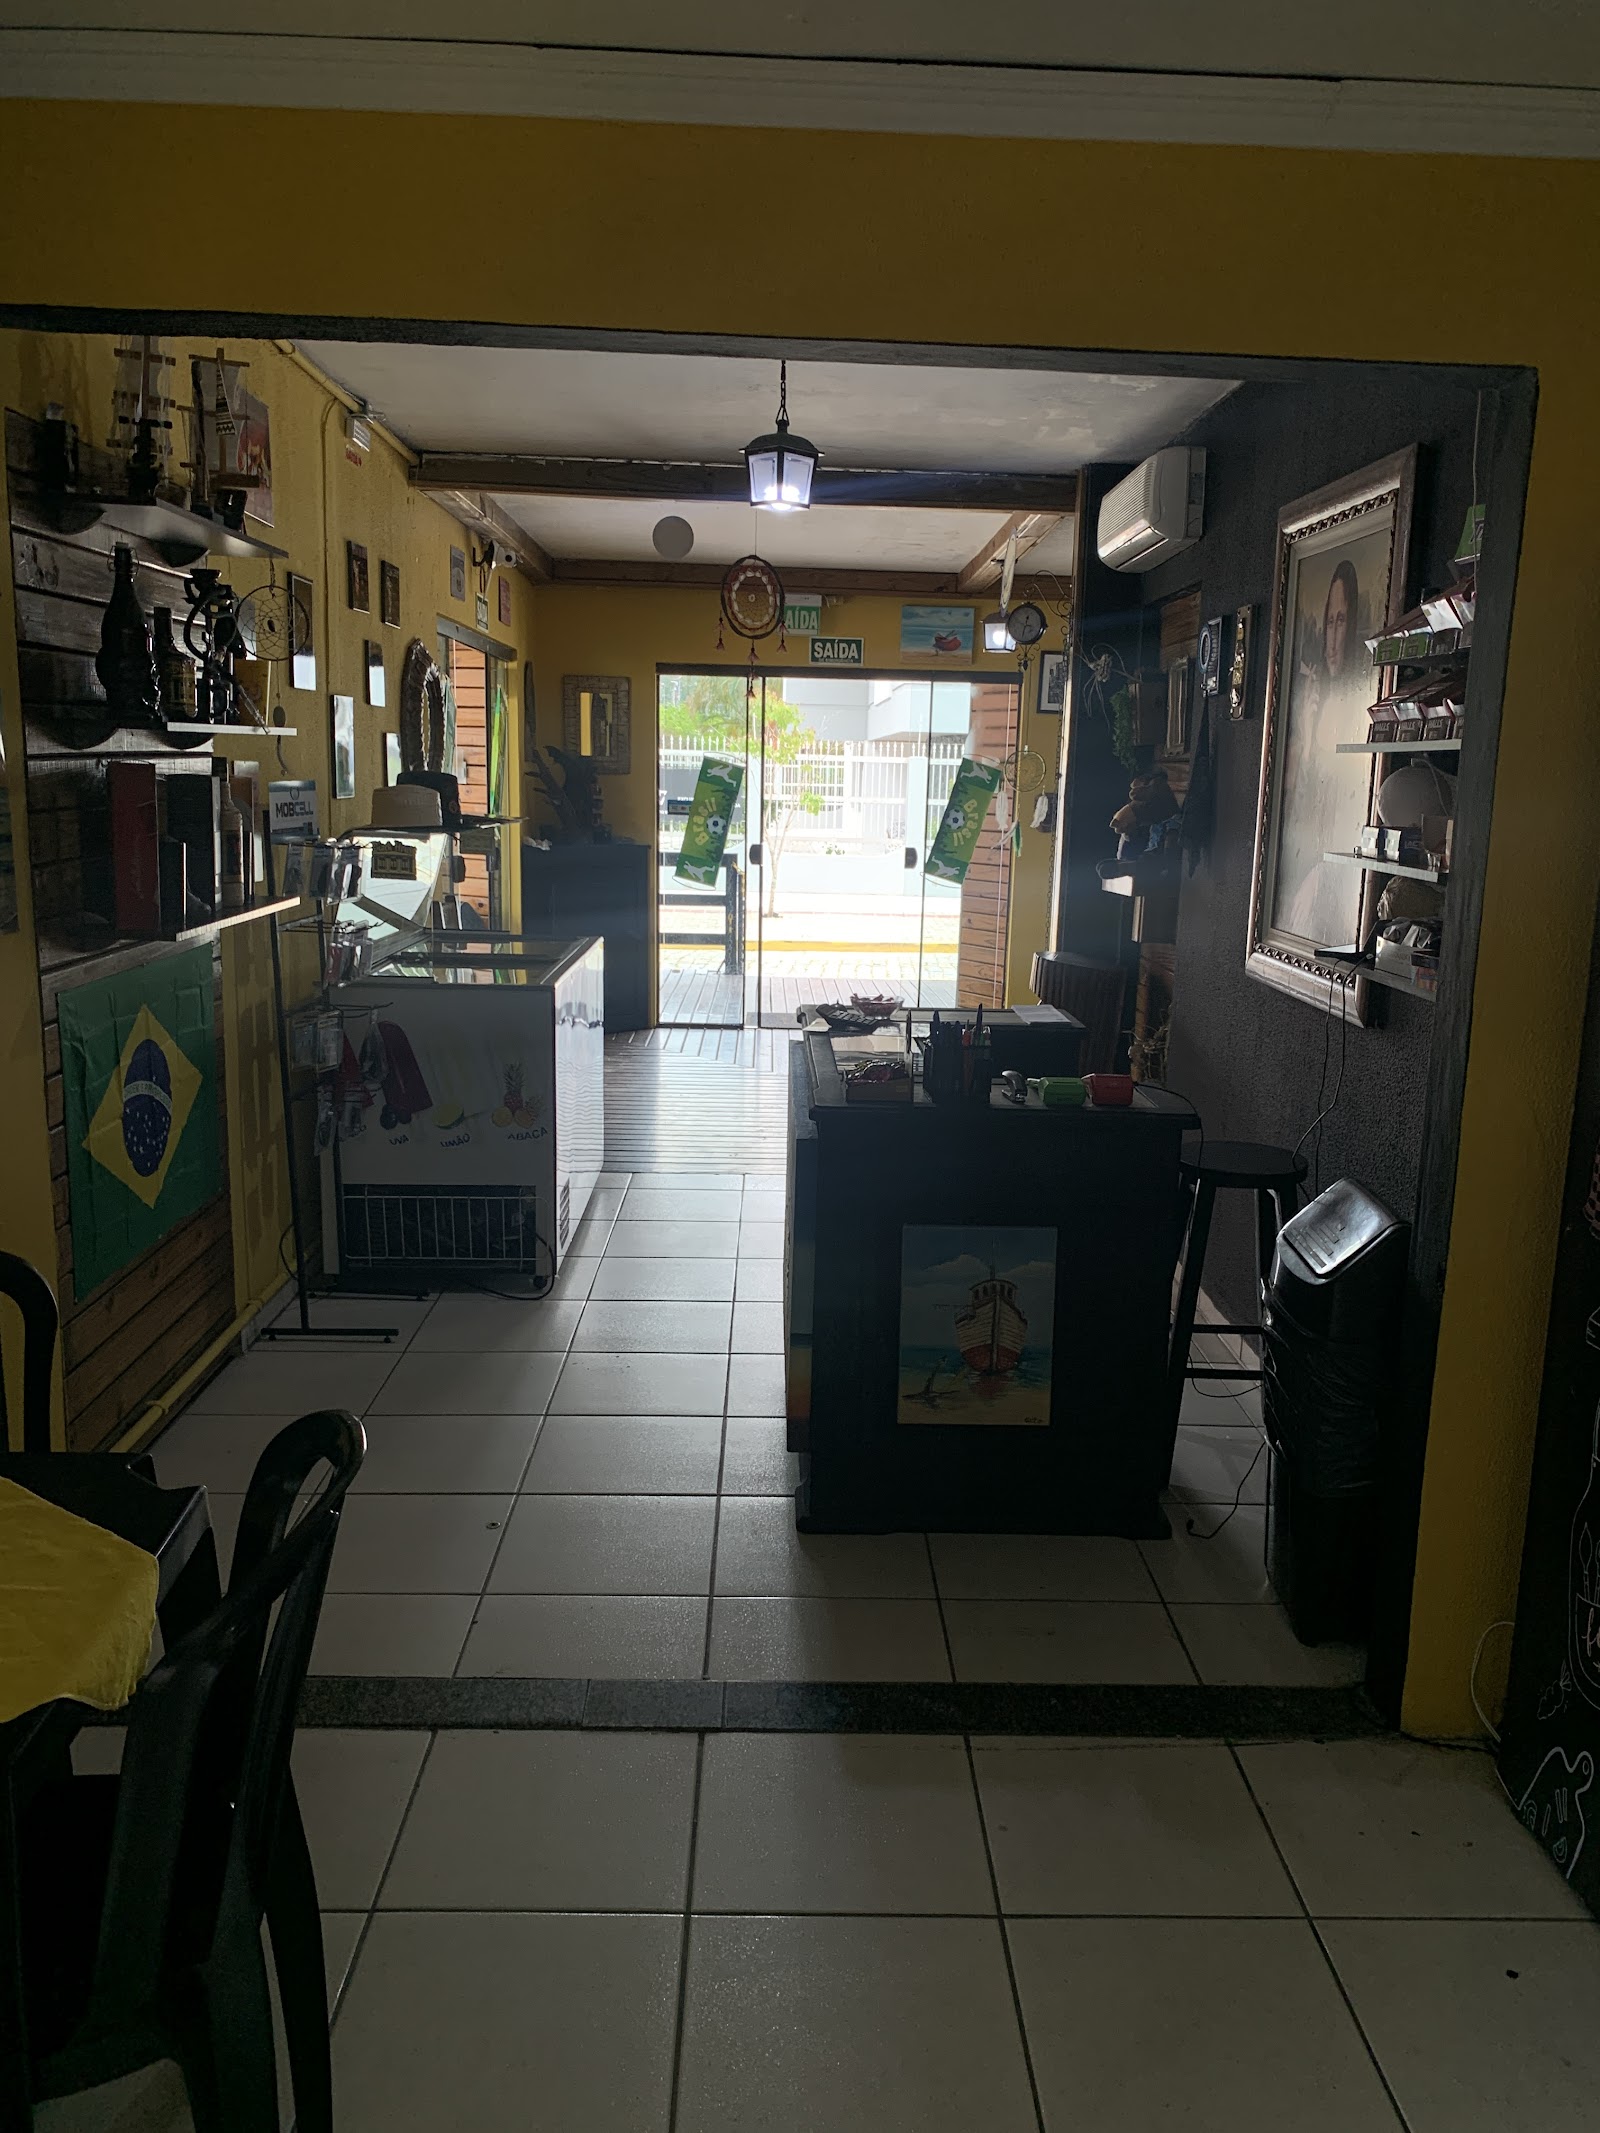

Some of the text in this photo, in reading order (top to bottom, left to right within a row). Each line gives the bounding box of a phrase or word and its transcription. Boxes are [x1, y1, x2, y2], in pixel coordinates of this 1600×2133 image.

[784, 606, 818, 630] AÍDA
[813, 639, 859, 660] SAÍDA
[275, 801, 314, 819] MOBCELL
[692, 797, 718, 846] Brasil
[952, 799, 979, 847] Brasil
[389, 1134, 410, 1146] UVA
